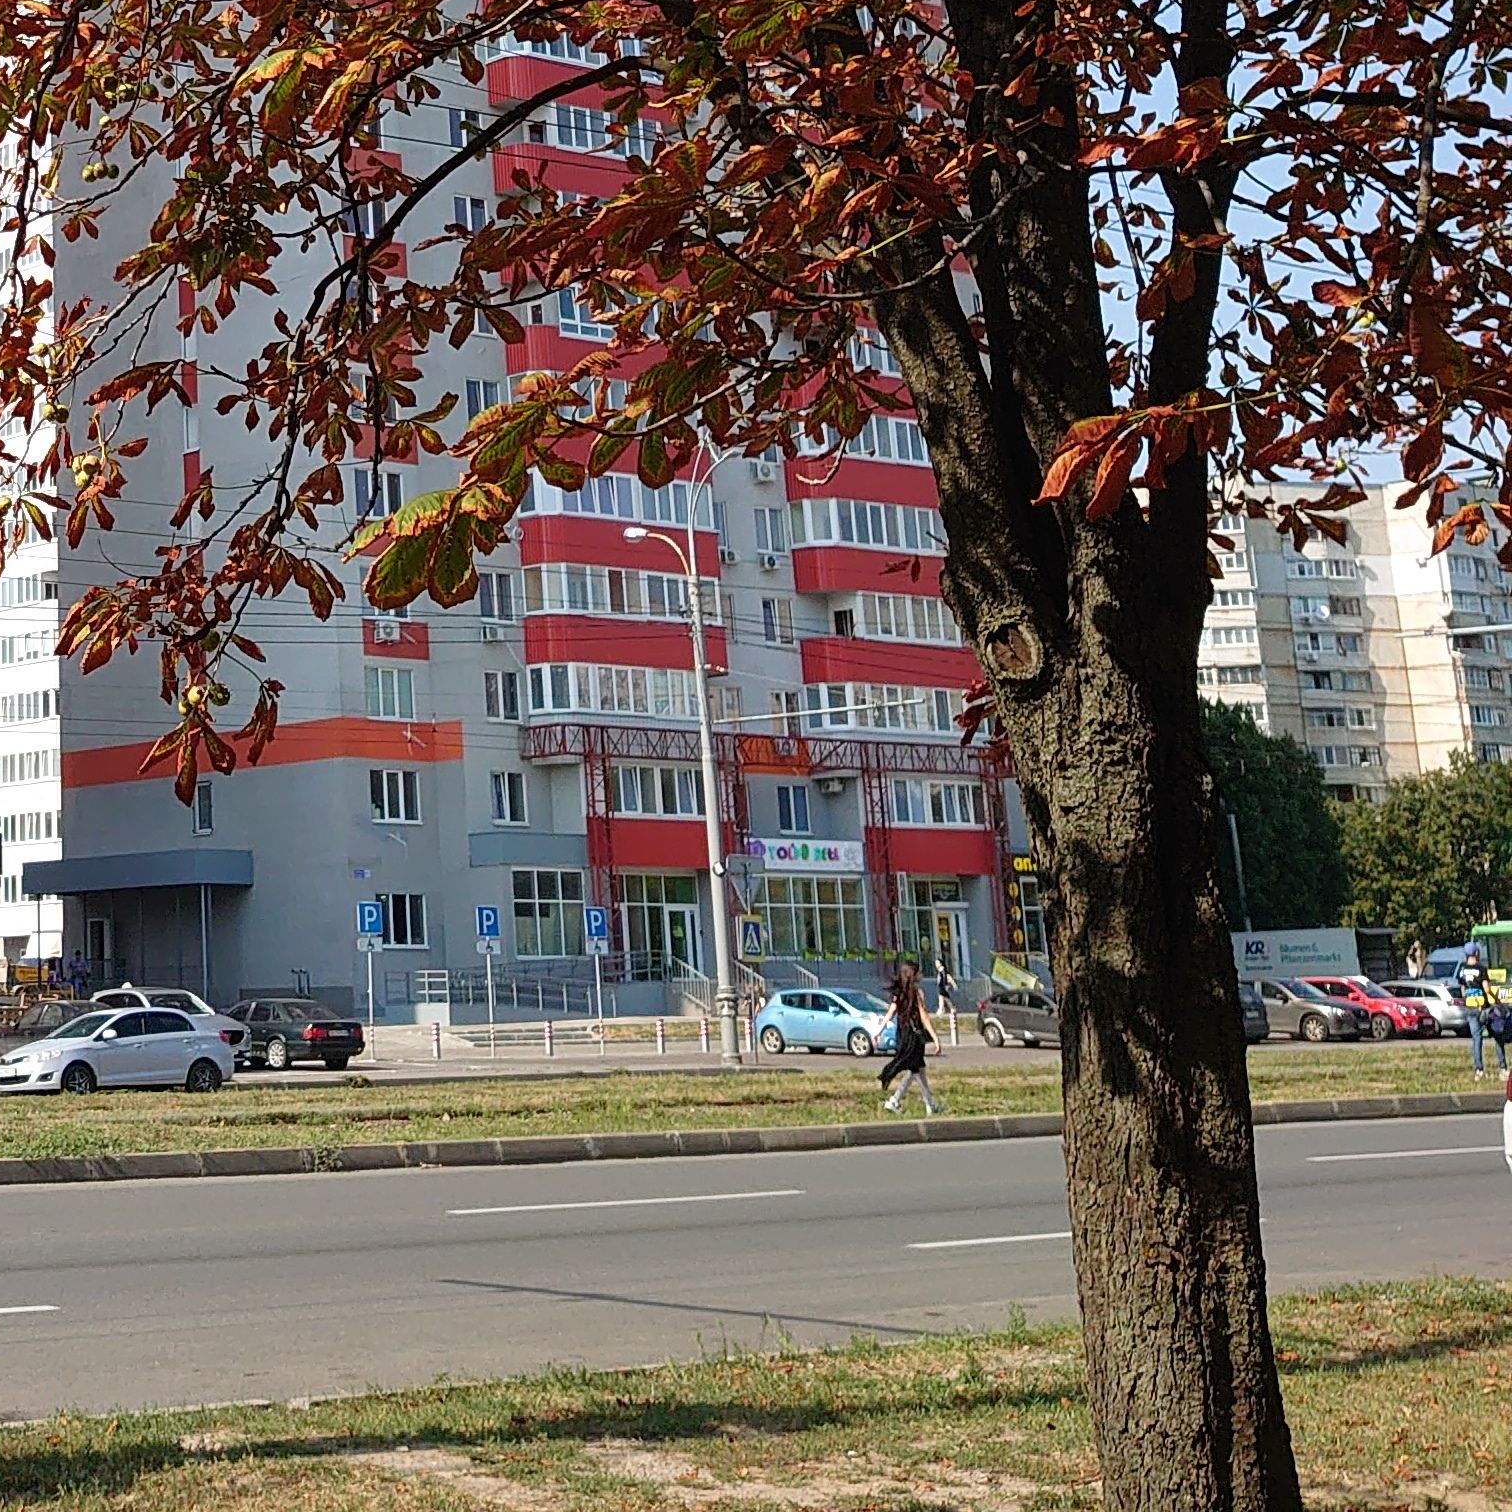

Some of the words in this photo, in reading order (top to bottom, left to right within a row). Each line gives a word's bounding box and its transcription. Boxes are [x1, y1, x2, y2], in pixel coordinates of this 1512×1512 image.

[364, 906, 377, 930] P
[482, 910, 494, 934] P
[590, 910, 602, 934] P
